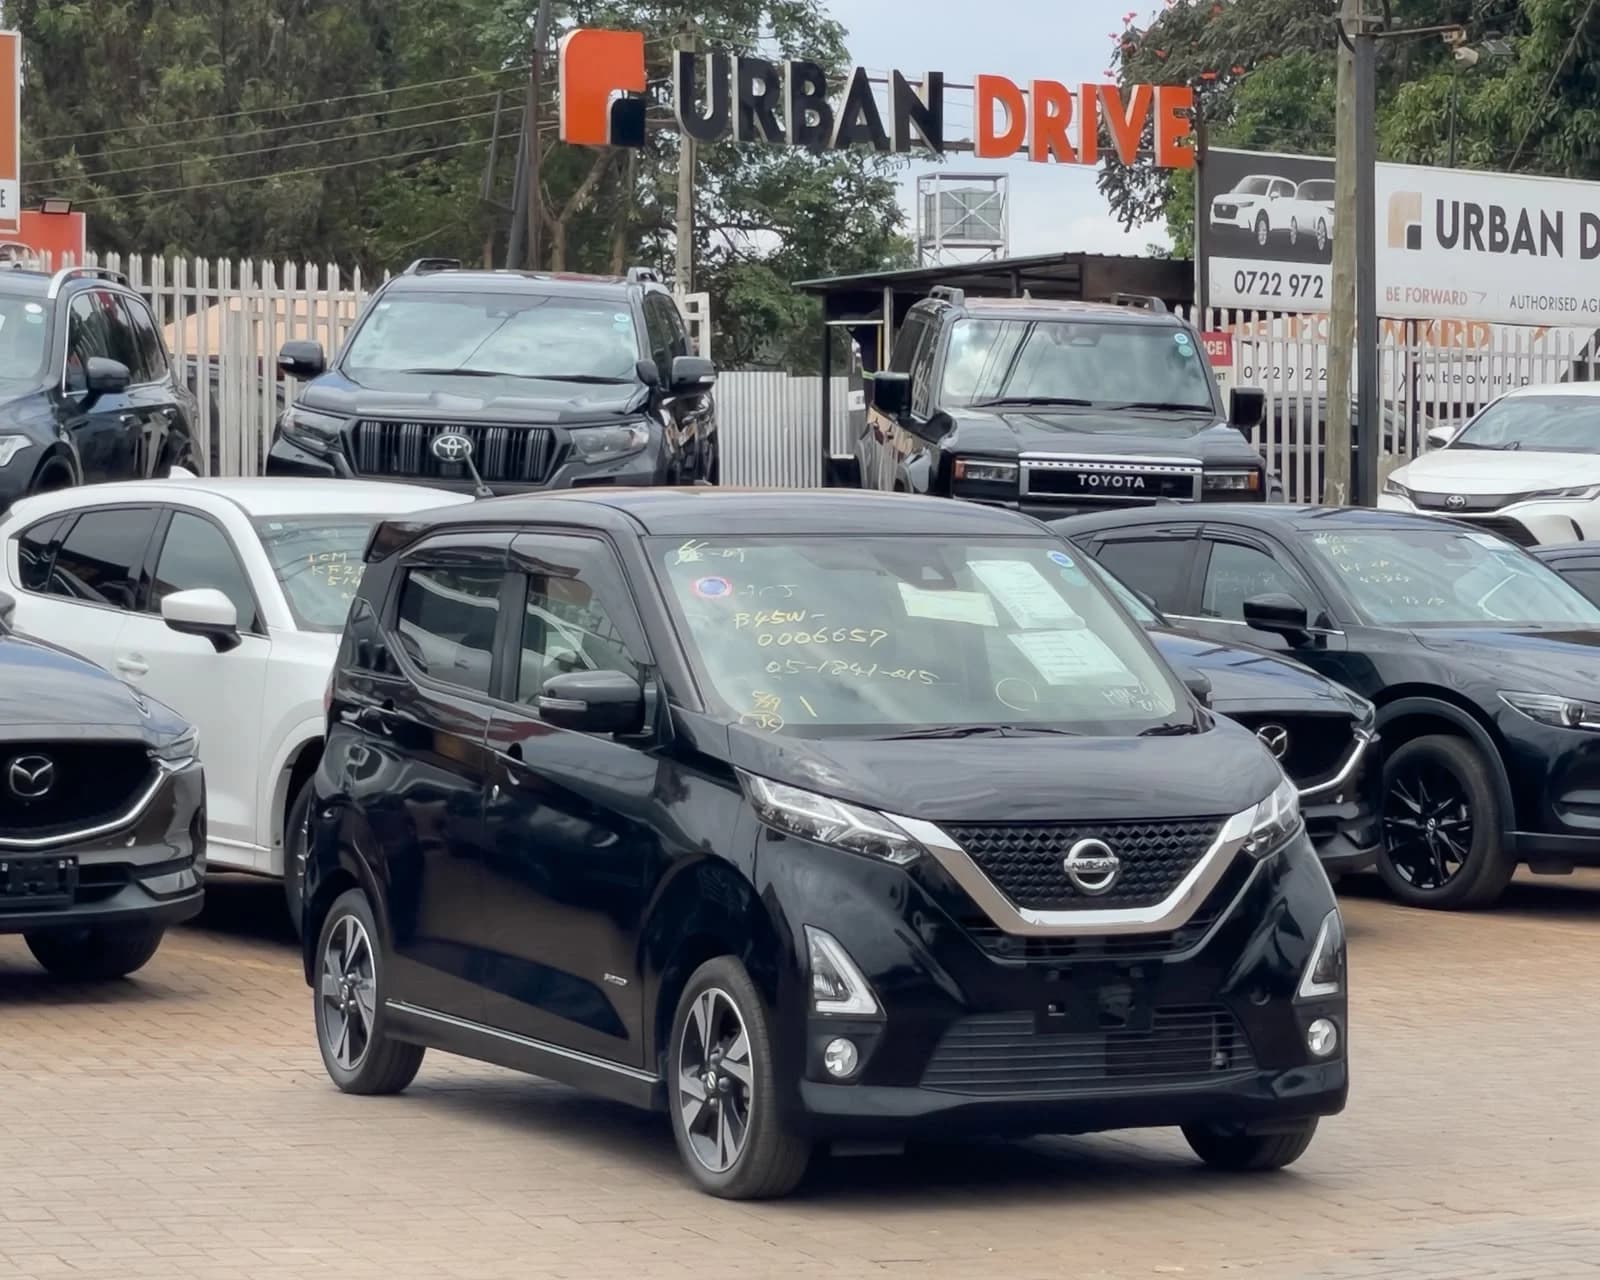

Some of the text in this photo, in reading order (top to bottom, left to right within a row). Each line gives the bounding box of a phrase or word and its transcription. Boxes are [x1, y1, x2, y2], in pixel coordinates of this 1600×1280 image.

[672, 50, 1194, 168] URBAN DRIVE
[1436, 198, 1563, 258] URBAN
[1234, 270, 1324, 299] 0722 972
[1386, 286, 1468, 305] BE FORWARD
[1510, 295, 1600, 313] AUTHORISED AG
[1077, 474, 1145, 488] TOYOTA
[757, 626, 888, 648] 0006657
